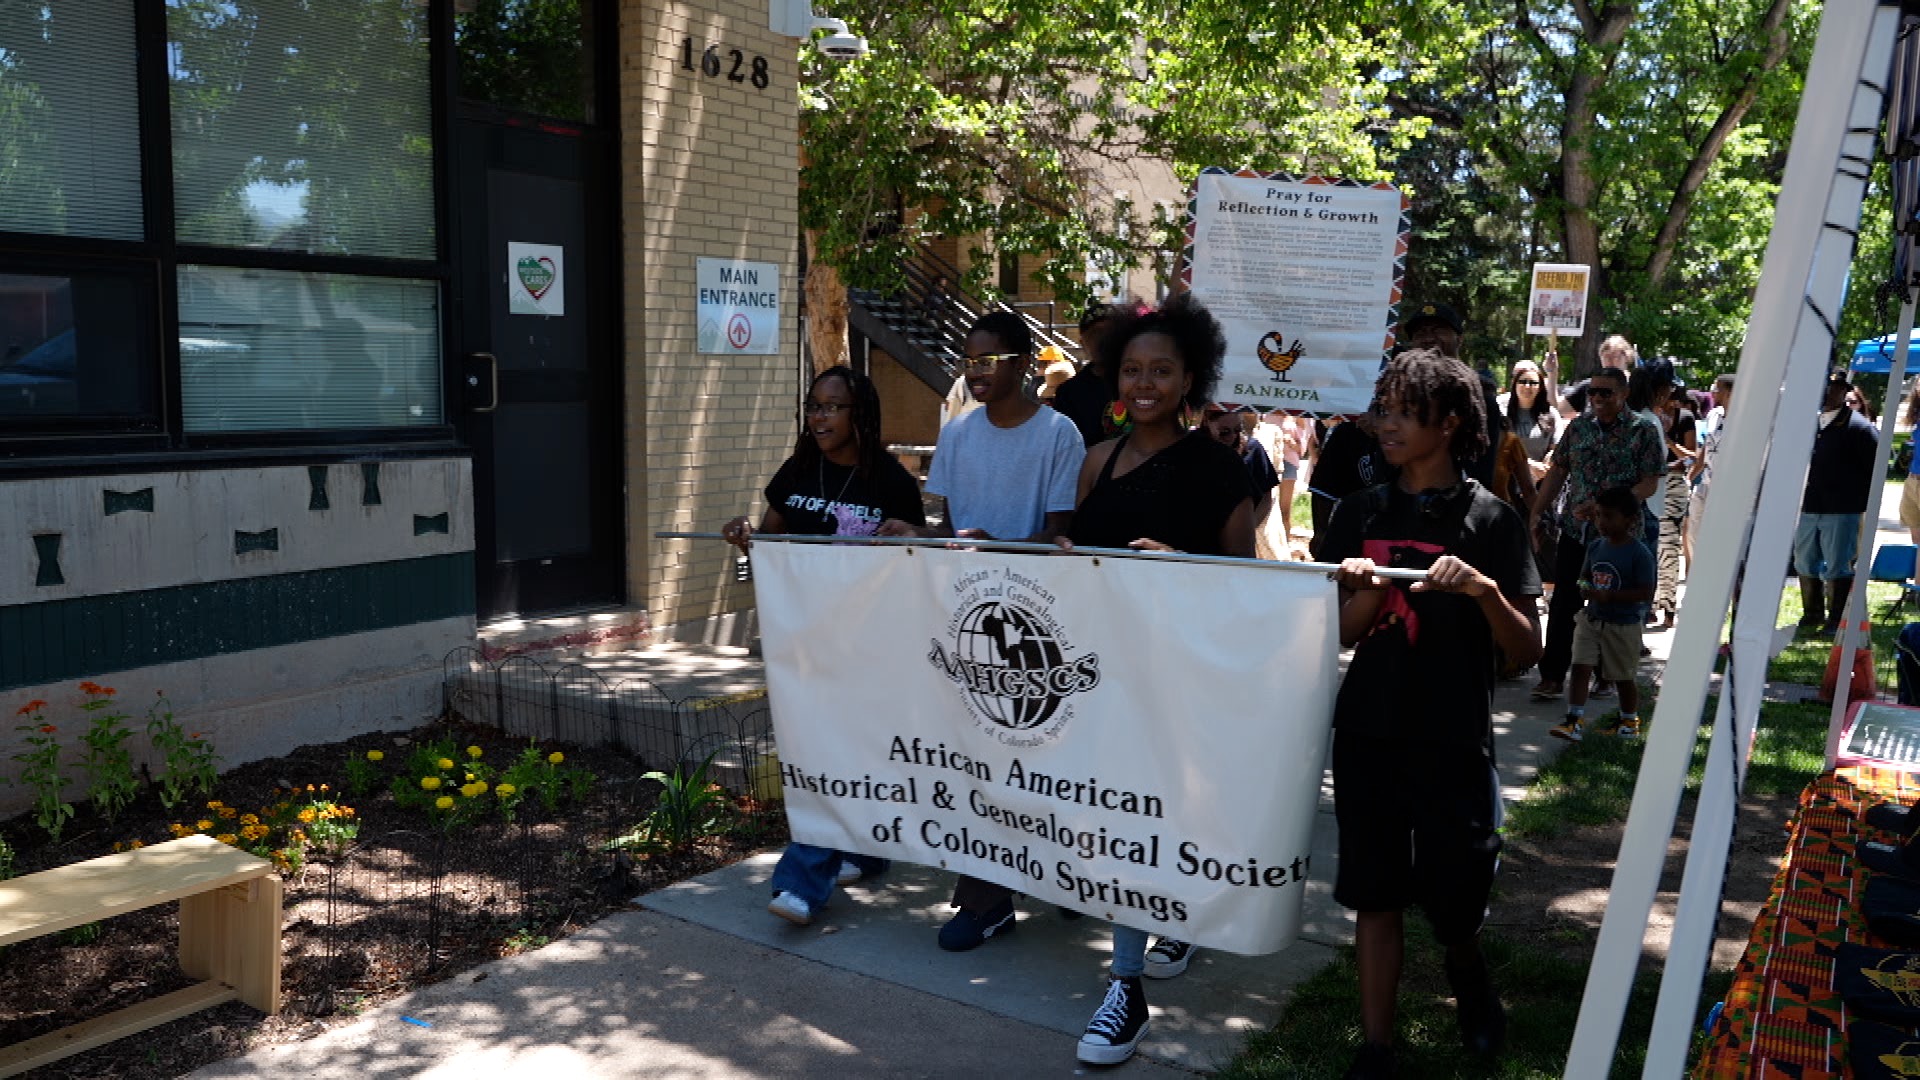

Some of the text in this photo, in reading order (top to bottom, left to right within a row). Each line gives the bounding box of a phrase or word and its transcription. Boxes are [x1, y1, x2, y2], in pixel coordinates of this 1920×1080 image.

[681, 37, 769, 90] 1628
[1218, 201, 1379, 224] Reflection & Growth
[1266, 188, 1332, 204] Pray for
[720, 267, 758, 285] MAIN
[700, 288, 776, 309] ENTRANCE
[1234, 384, 1321, 402] SANKOFA
[805, 497, 826, 512] OF
[953, 570, 989, 595] African
[1002, 567, 1056, 605] American
[983, 581, 1003, 597] and
[1006, 585, 1075, 651] Genealogical
[928, 637, 1101, 699] AAHGSCS
[889, 735, 1164, 819] African American
[779, 761, 919, 805] Historical
[932, 780, 956, 811] &
[969, 789, 1160, 869] Genealogical
[871, 816, 1189, 923] of Colorado Springs
